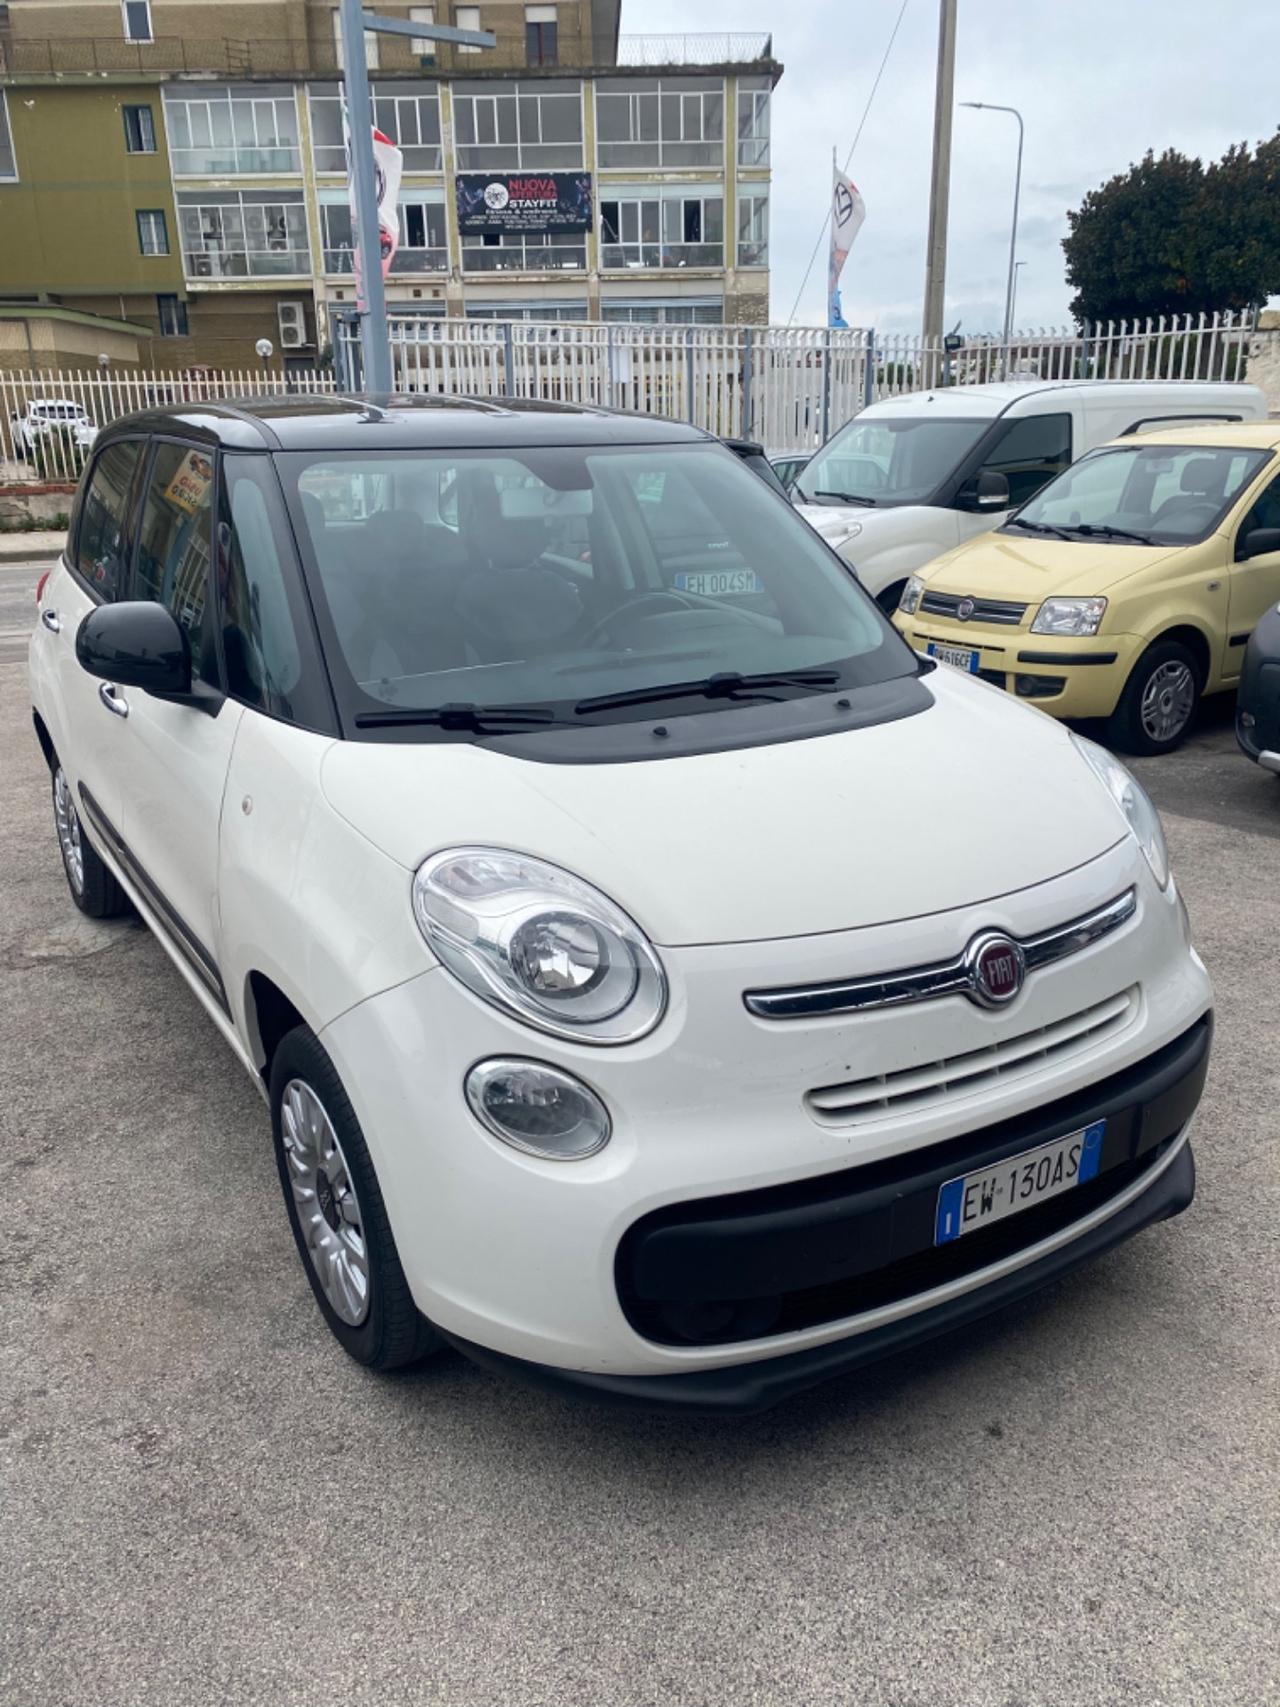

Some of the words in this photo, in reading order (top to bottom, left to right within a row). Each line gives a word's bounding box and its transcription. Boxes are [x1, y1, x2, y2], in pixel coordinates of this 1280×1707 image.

[509, 179, 556, 191] NUOVA
[509, 199, 557, 209] STAYFIT
[986, 955, 1013, 987] FIAT
[962, 1177, 997, 1223] EW
[1008, 1144, 1081, 1205] 130AS
